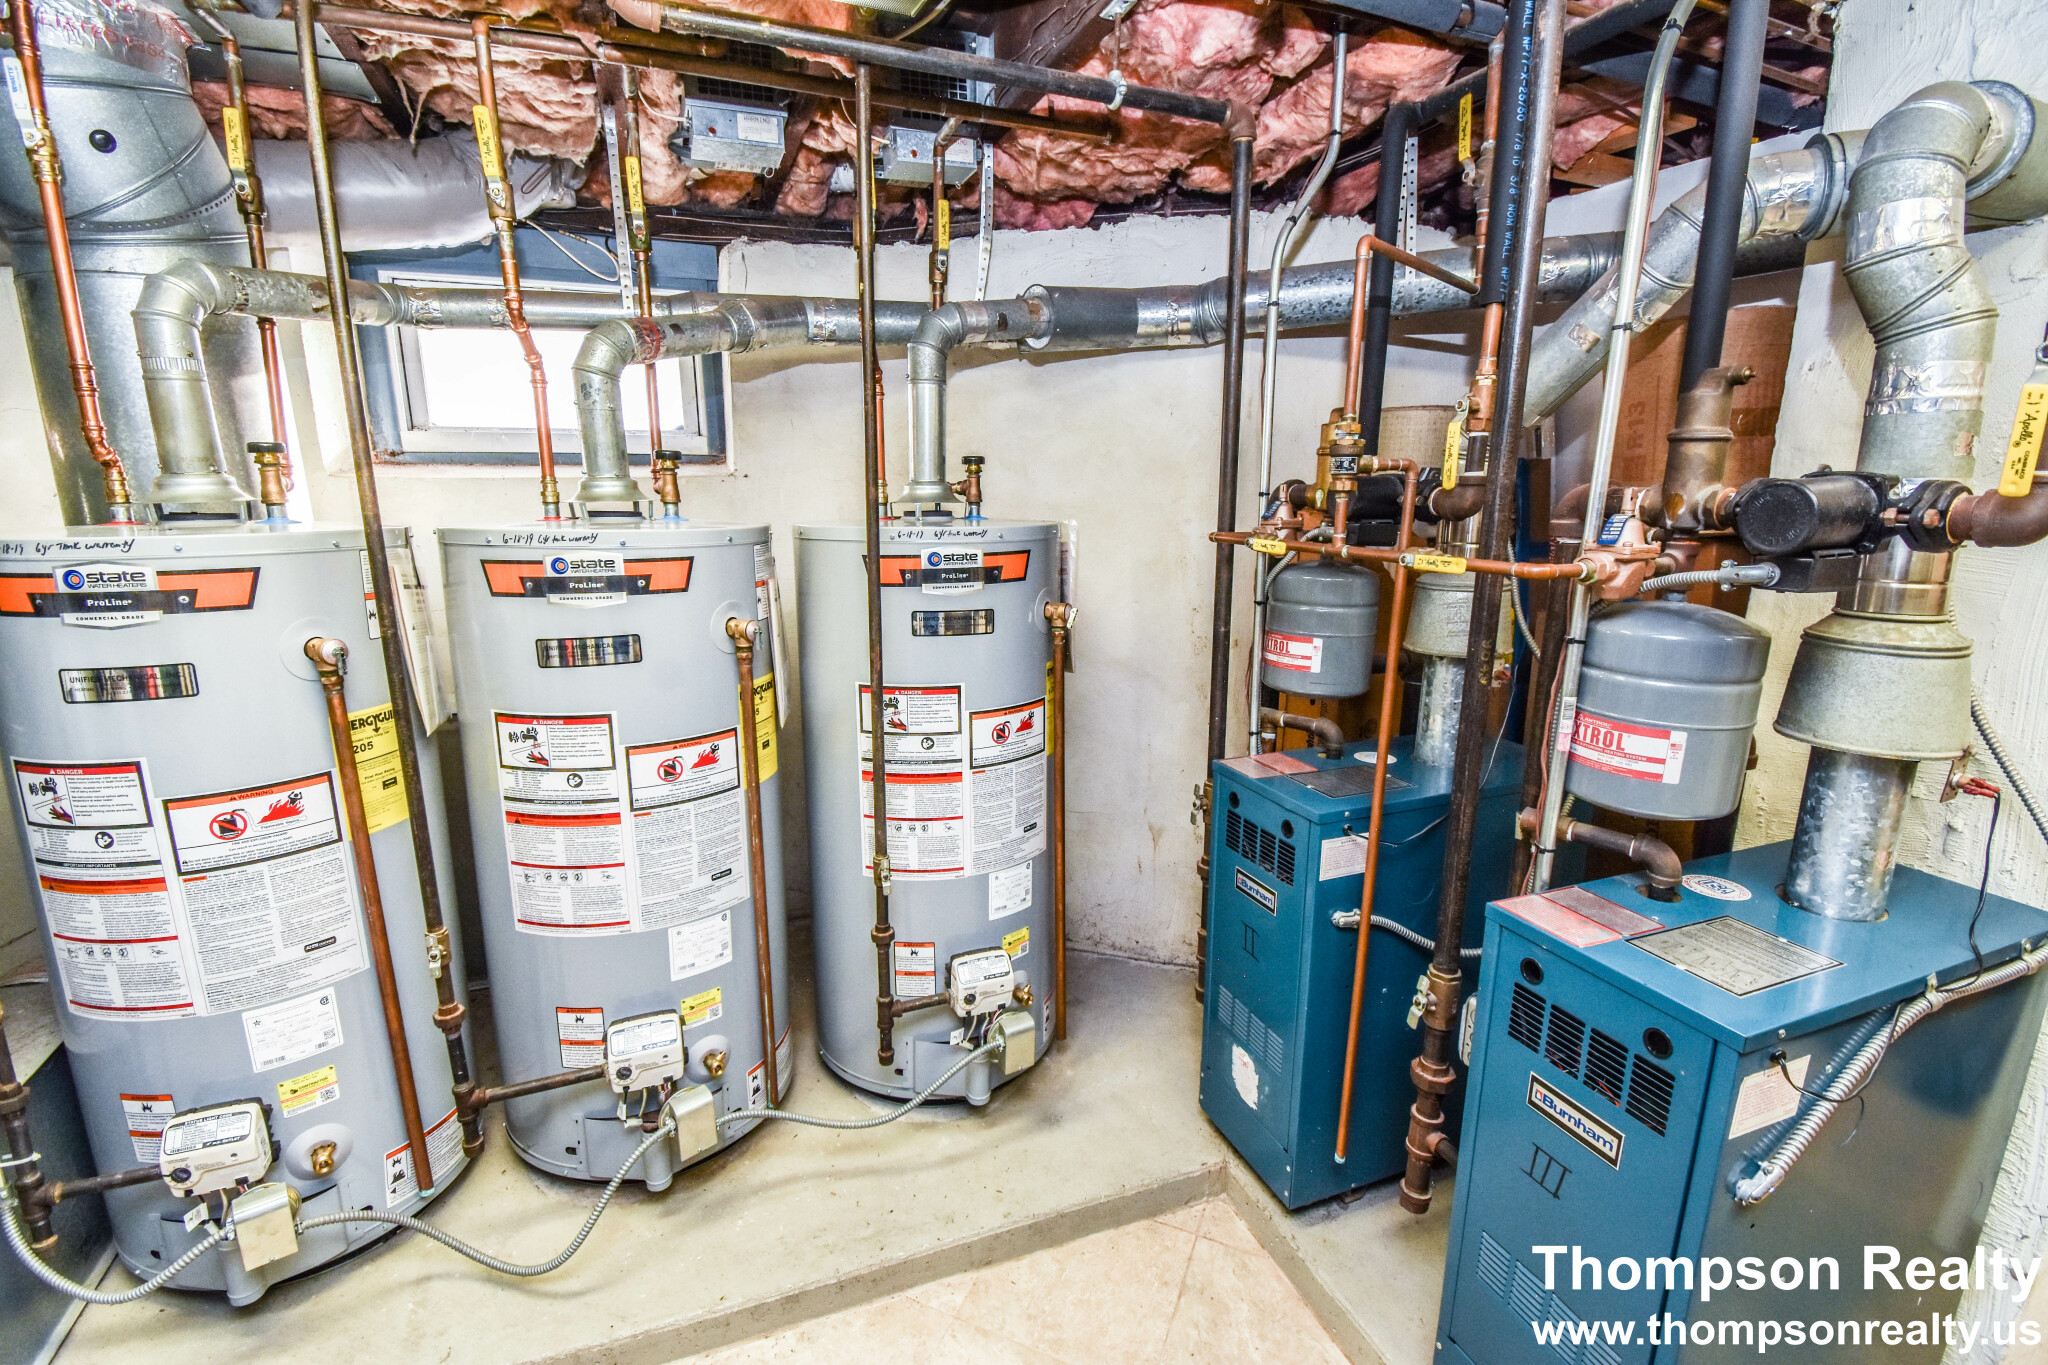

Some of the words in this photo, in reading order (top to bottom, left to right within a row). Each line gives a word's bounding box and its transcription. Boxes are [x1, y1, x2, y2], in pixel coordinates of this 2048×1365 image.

[1506, 203, 1516, 226] NOM
[1502, 231, 1513, 259] WALL
[569, 558, 616, 570] state
[943, 552, 979, 562] state
[86, 570, 147, 584] state
[1573, 721, 1625, 752] XTROL
[353, 740, 374, 755] 205
[237, 788, 274, 800] WARNING
[1241, 880, 1273, 906] Burnham
[1542, 1093, 1614, 1153] Burnham
